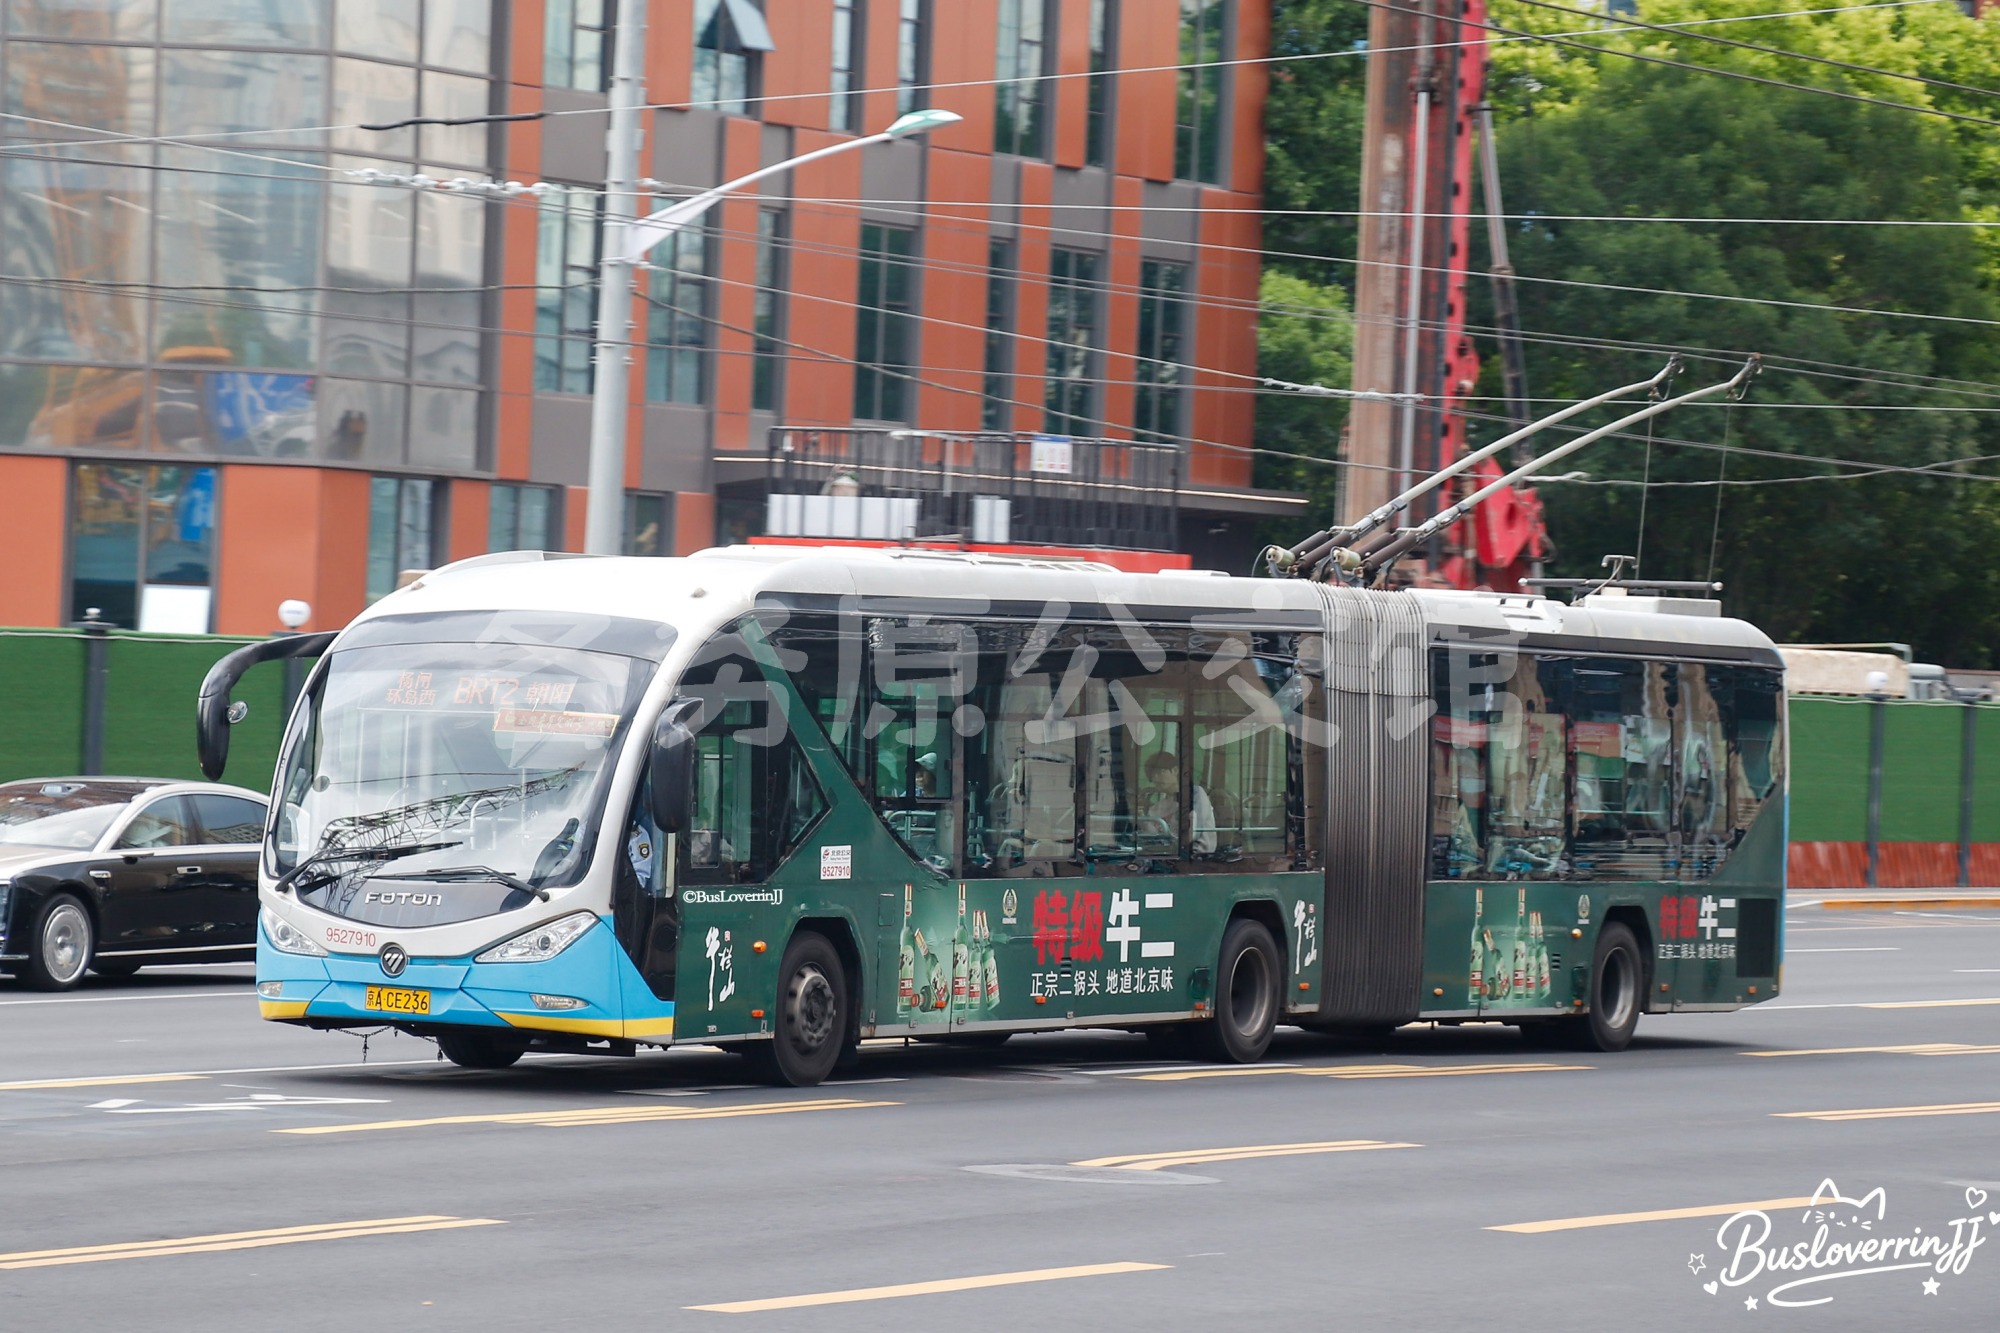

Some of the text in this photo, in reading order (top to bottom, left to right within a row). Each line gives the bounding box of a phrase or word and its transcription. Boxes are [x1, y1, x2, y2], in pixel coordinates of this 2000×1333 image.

[385, 688, 437, 706] 环岛西
[454, 676, 520, 705] BRT2
[822, 865, 850, 877] 9527910
[364, 891, 442, 906] FOTON
[326, 927, 377, 948] 9527910
[1030, 969, 1100, 998] 正宗二锅头
[1105, 966, 1174, 996] 地道北京味
